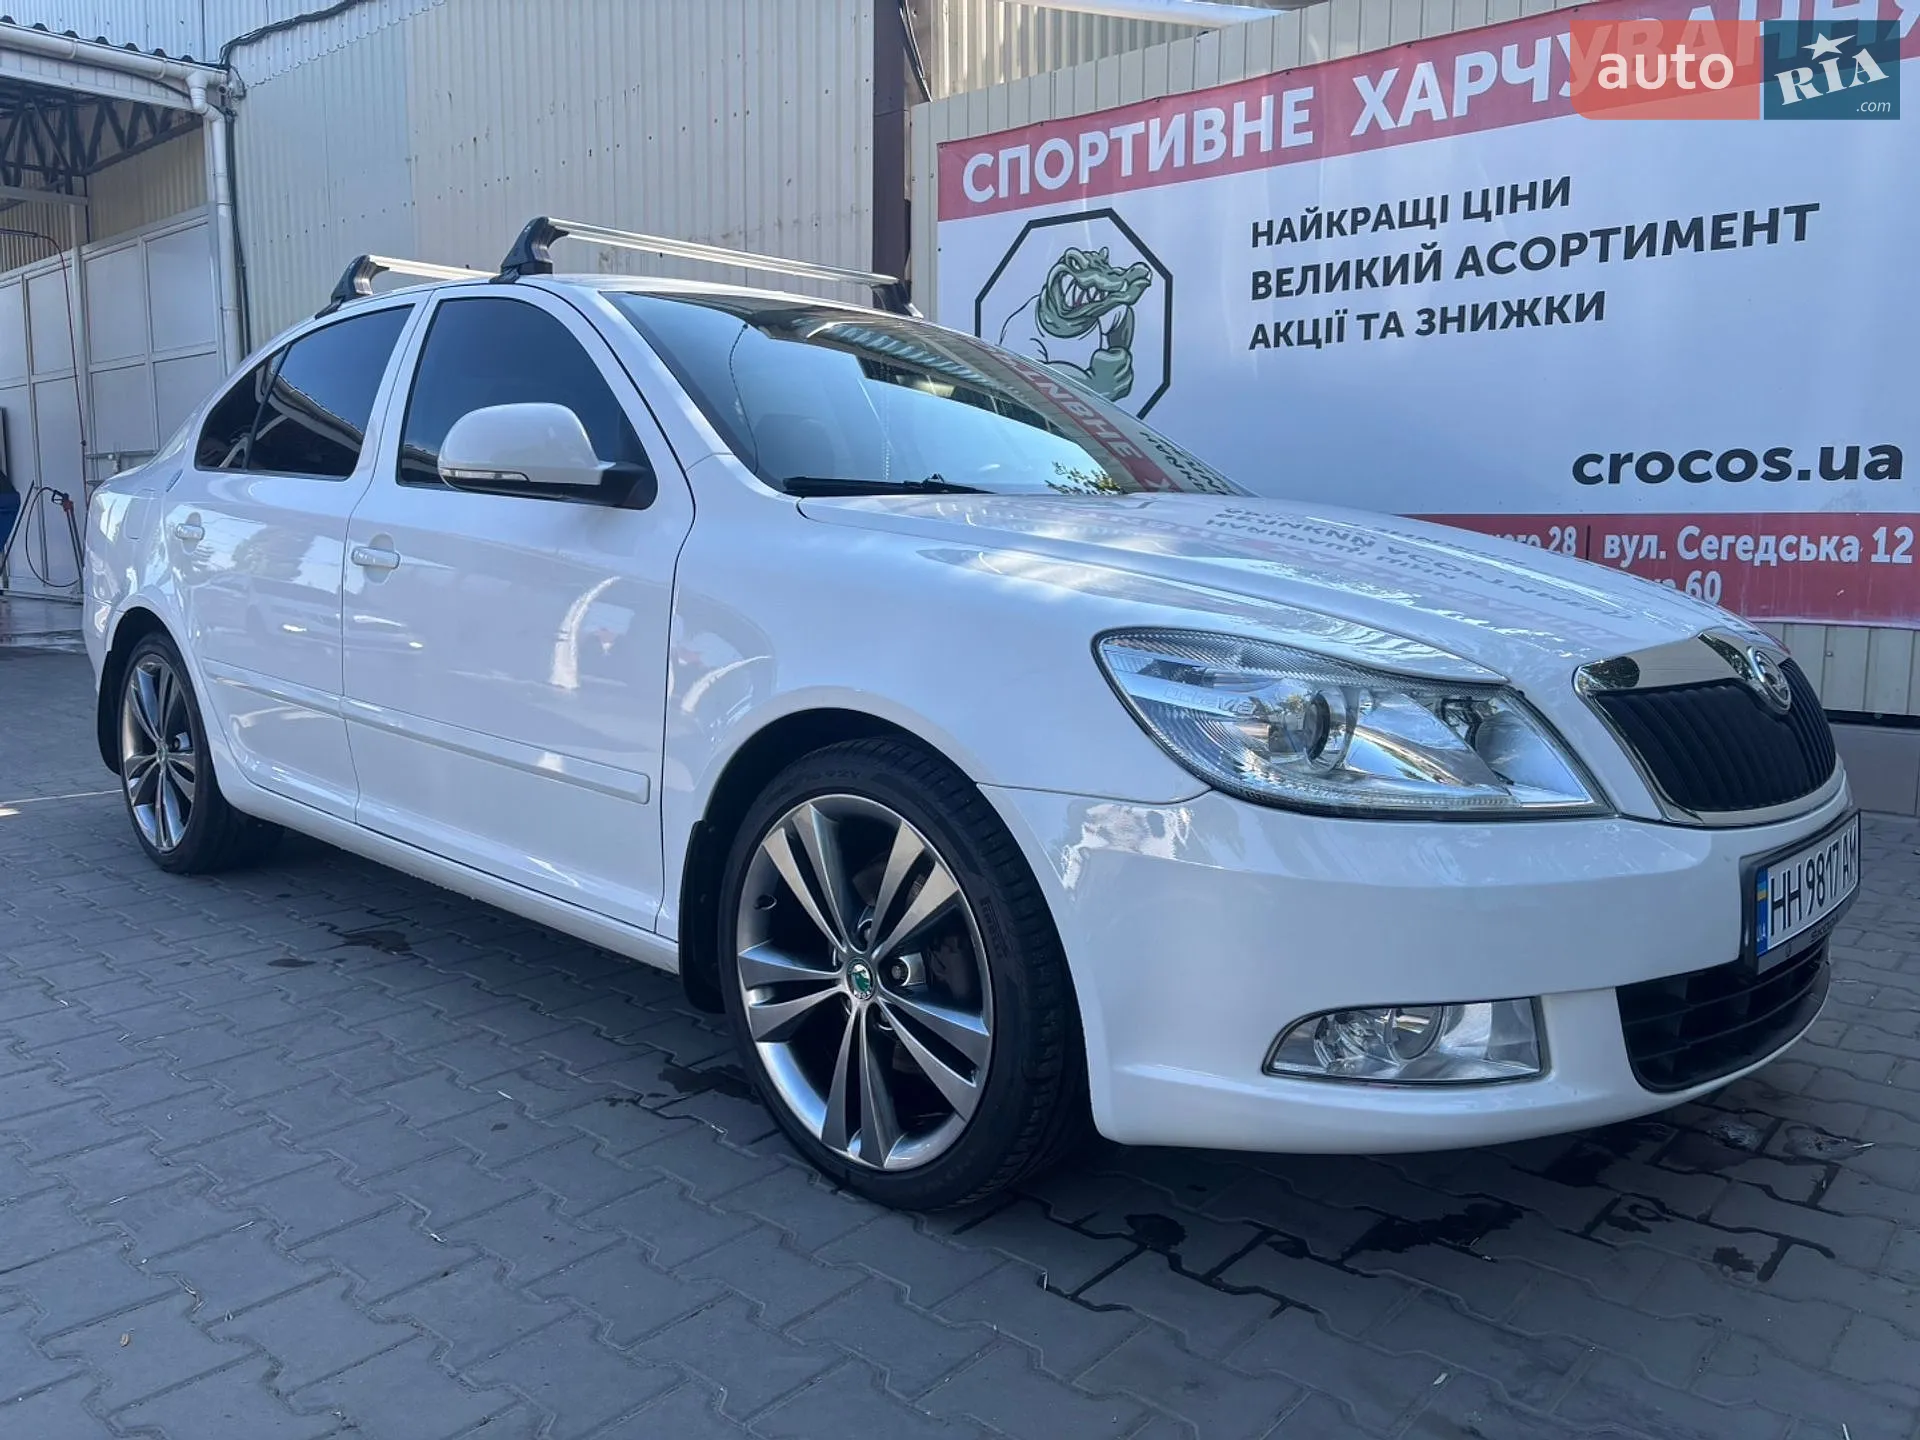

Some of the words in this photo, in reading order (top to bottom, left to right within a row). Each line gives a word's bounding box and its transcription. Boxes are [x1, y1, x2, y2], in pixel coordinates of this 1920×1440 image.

[962, 86, 1314, 203] СПОРТИВНЕ
[1251, 194, 1449, 248] НАЙКРАЩІ
[1463, 176, 1571, 222] ЦІНИ
[1251, 241, 1443, 300] ВЕЛИКИЙ
[1454, 202, 1820, 279] АСОРТИМЕНТ
[1249, 309, 1348, 350] АКЦІЇ
[1356, 311, 1405, 341] ТА
[1415, 291, 1605, 337] ЗНИЖКИ
[1572, 444, 1904, 485] crocos.ua
[1548, 525, 1577, 557] 28
[1603, 533, 1667, 568] вул.
[1676, 525, 1860, 567] Сегедська
[1870, 526, 1914, 564] 12
[1685, 570, 1722, 604] 60
